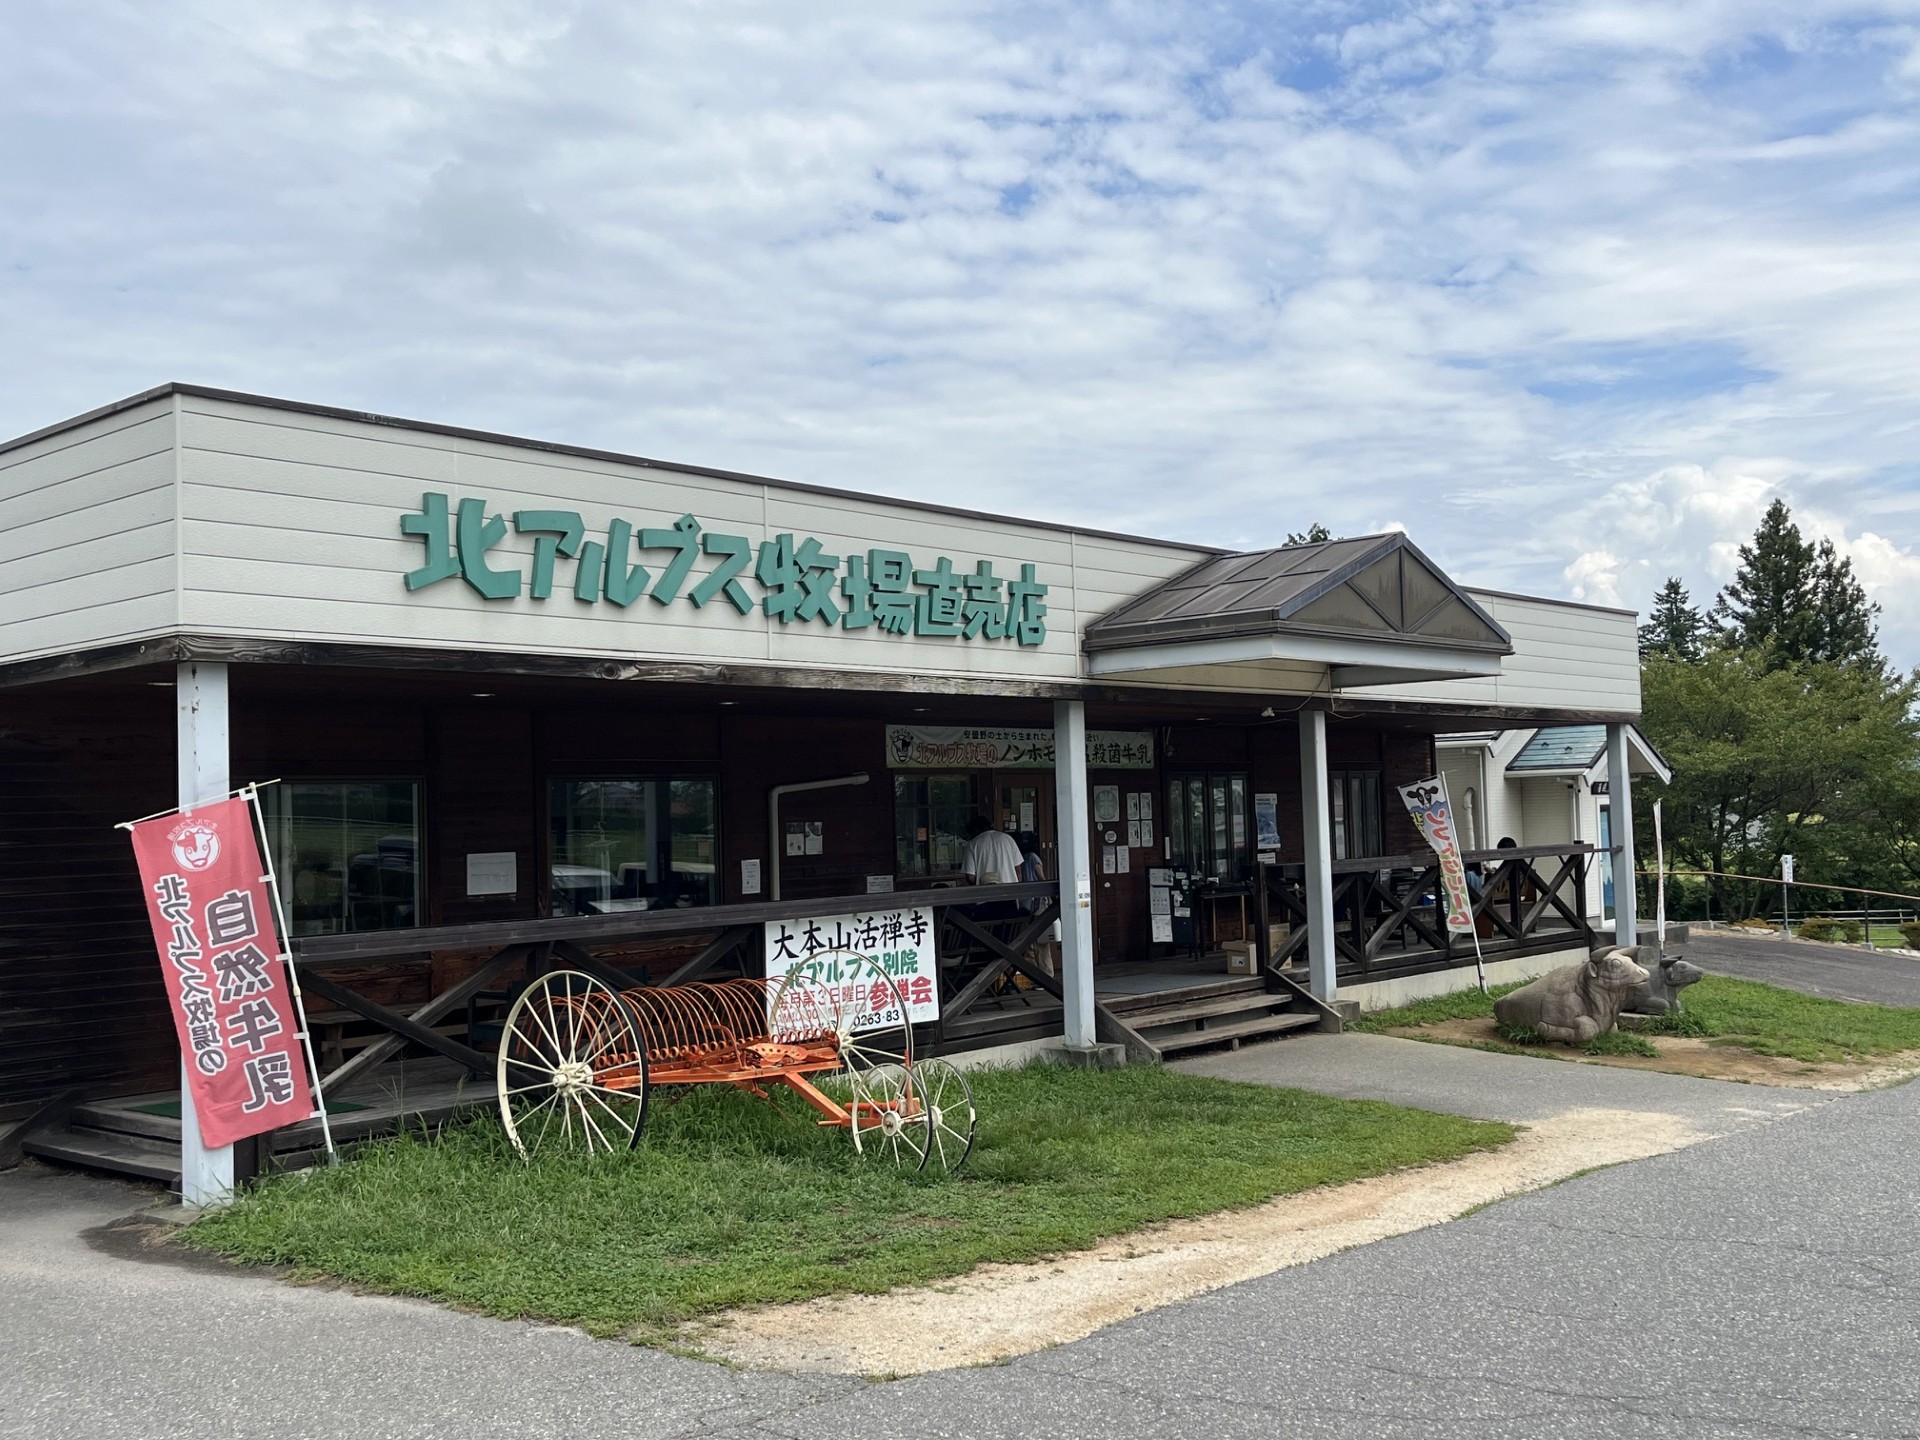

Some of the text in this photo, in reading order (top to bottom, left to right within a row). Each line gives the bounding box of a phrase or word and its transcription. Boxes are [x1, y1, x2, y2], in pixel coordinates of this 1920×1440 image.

[401, 491, 1049, 646] 北アルプス牧場直売店
[1085, 742, 1152, 764] 殺菌牛乳
[771, 910, 929, 961] 大本山活禅寺
[870, 976, 932, 1012] 参禅会
